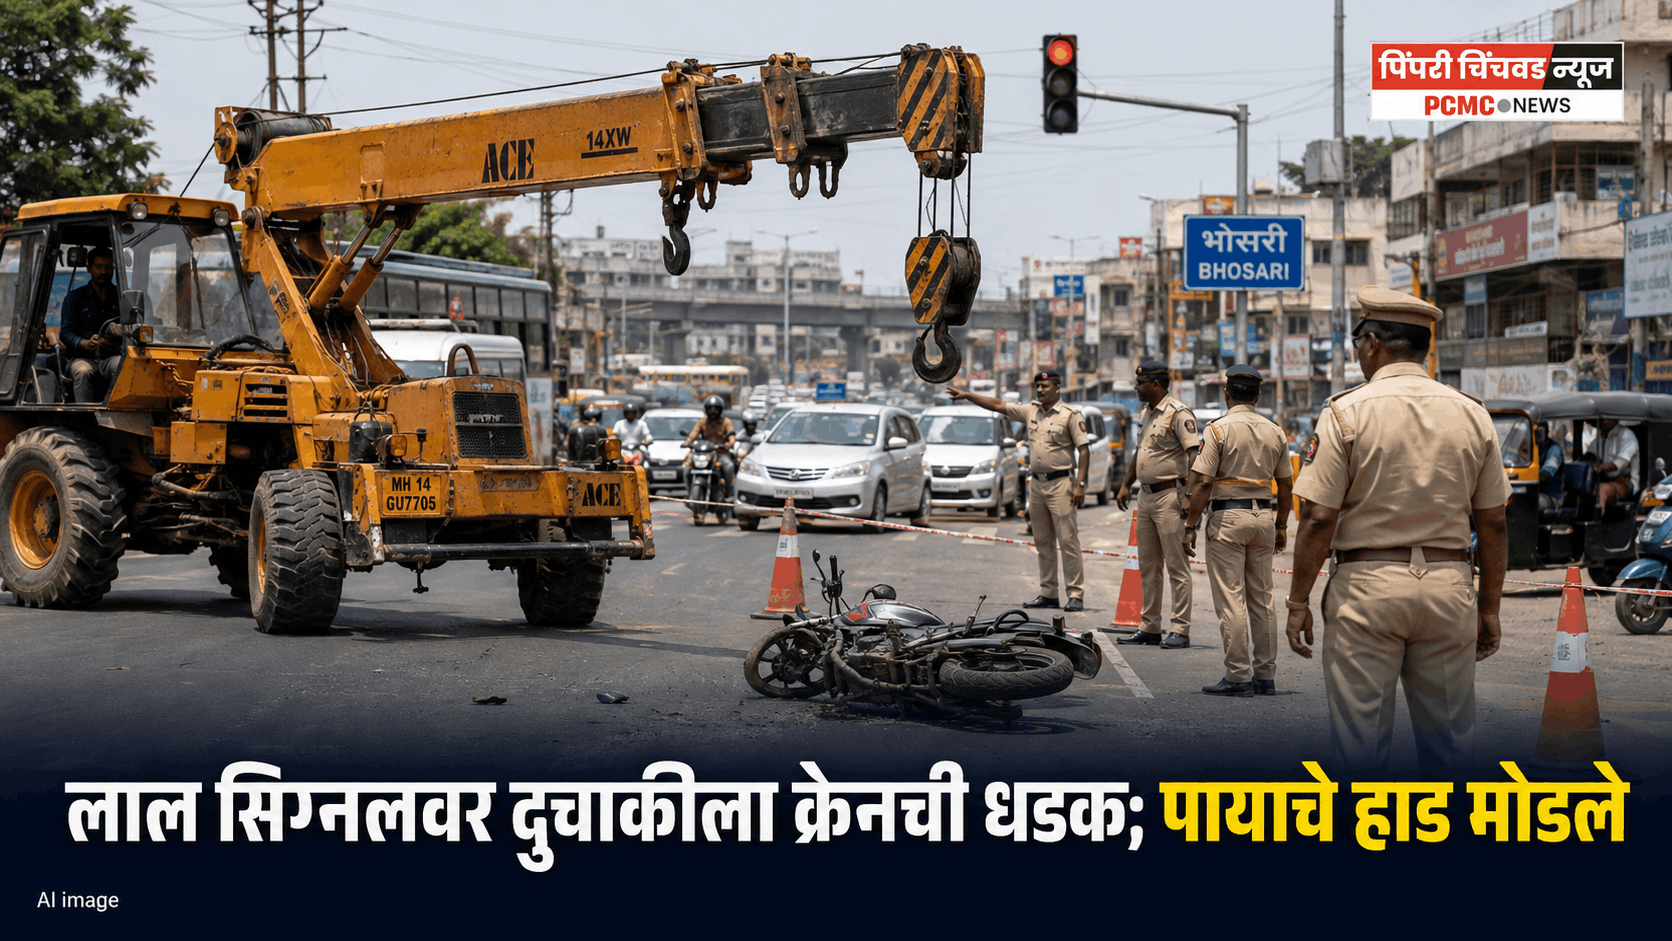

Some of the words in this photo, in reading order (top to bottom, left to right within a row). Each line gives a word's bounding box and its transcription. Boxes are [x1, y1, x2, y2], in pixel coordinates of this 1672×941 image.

[586, 126, 632, 151] 14XW
[481, 138, 535, 183] ACE
[1201, 222, 1288, 253] भोसरी
[1198, 262, 1289, 280] BHOSARI
[391, 476, 411, 492] MH
[416, 476, 432, 492] 14
[581, 482, 621, 507] ACE
[386, 495, 436, 511] GU7705
